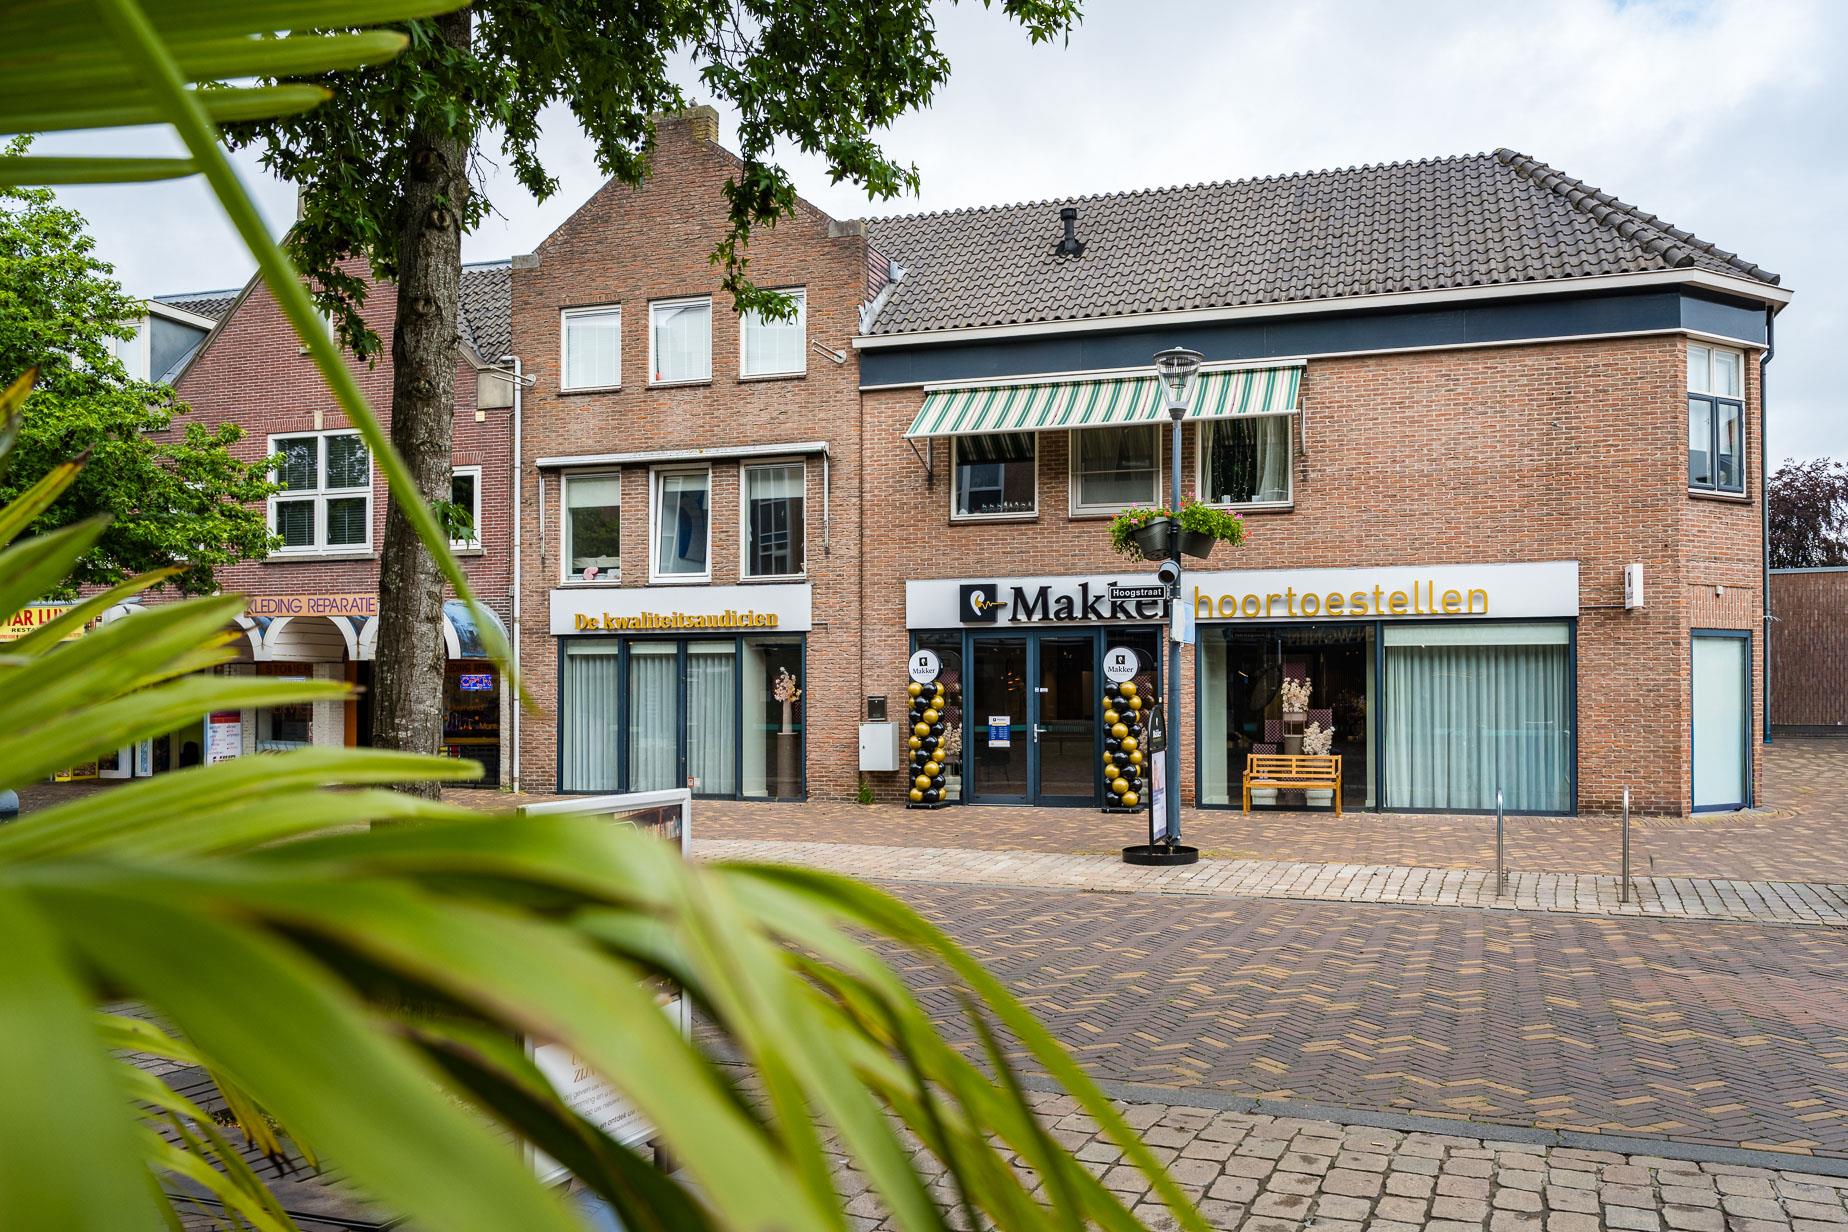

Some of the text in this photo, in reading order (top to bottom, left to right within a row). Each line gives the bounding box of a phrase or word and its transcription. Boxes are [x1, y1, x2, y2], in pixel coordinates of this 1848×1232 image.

[1113, 588, 1161, 599] Hoogstraat
[1194, 580, 1489, 618] hoortoestellen
[308, 597, 376, 613] REPARATIE
[574, 609, 779, 631] De kwaliteitsaudicien
[912, 667, 936, 675] Makker
[1107, 665, 1134, 673] Makker
